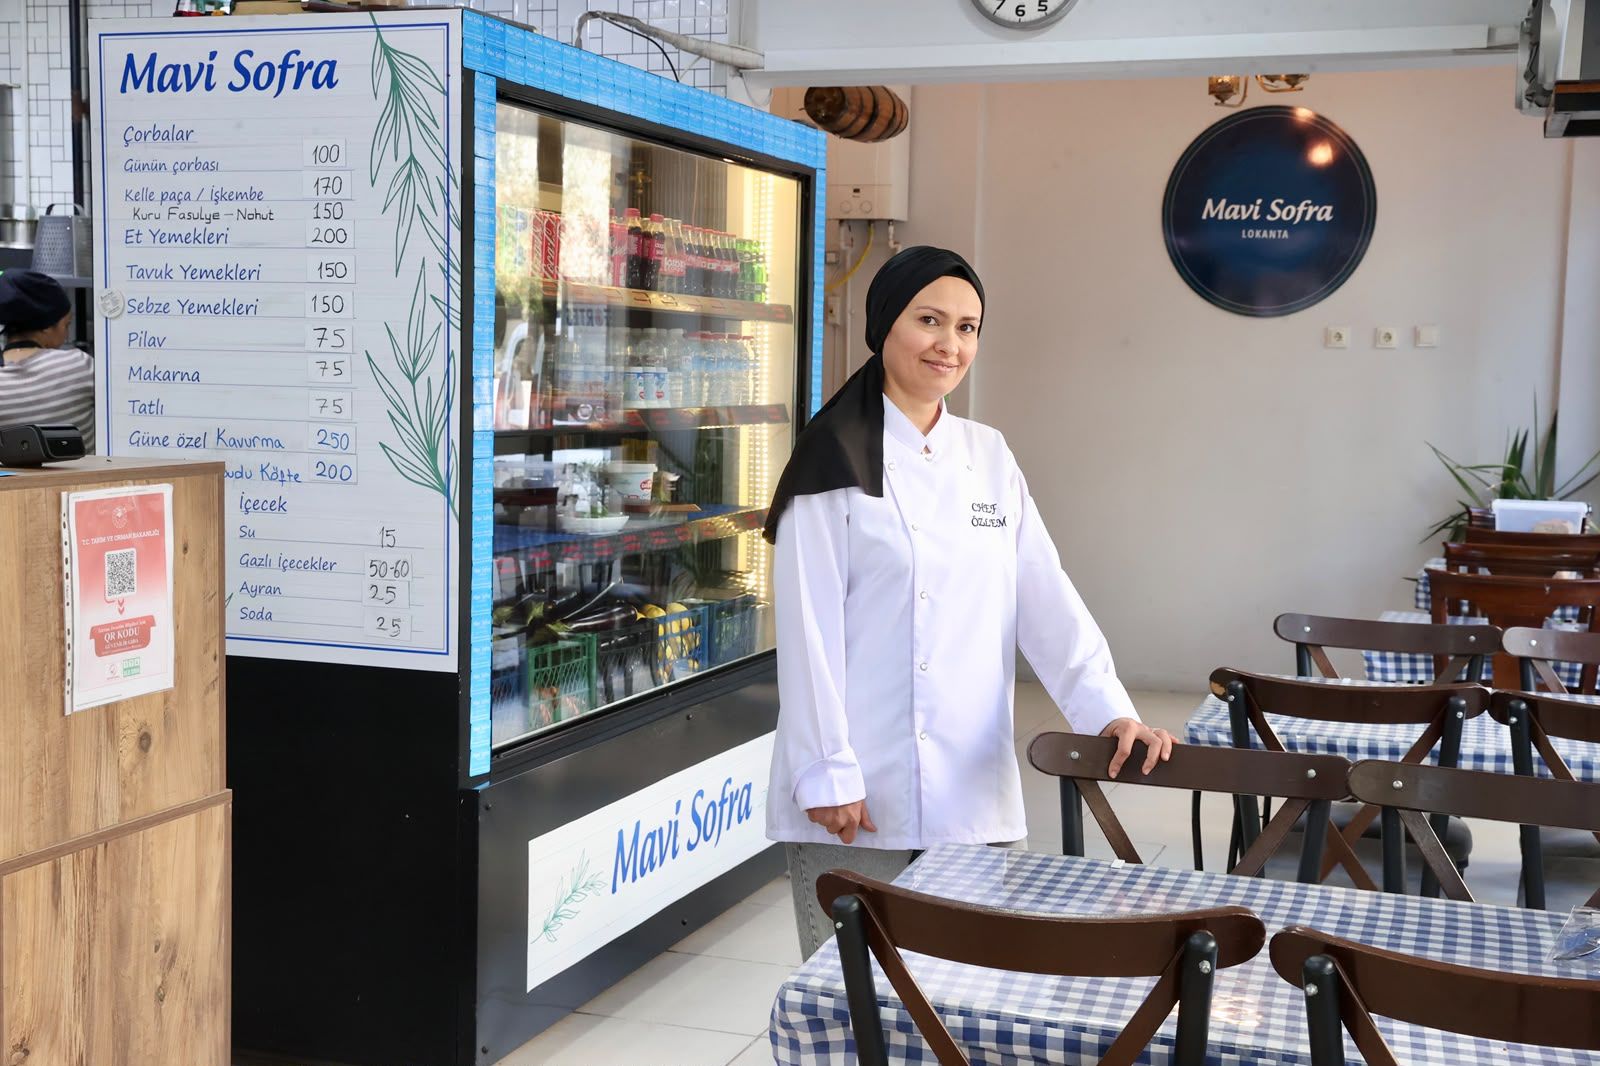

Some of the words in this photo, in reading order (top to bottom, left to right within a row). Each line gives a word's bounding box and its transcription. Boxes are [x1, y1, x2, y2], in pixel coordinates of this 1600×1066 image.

[1015, 5, 1025, 16] 6
[1038, 0, 1048, 11] 5
[120, 50, 218, 94] Mavi
[228, 49, 339, 98] Sofra
[124, 125, 194, 147] Çorbalar
[313, 144, 339, 164] 100
[124, 159, 167, 172] Günün
[173, 158, 219, 175] çorbası
[313, 176, 342, 195] 170
[125, 189, 156, 201] Kelle
[160, 192, 192, 205] paça
[211, 185, 263, 205] İşkembe
[133, 208, 161, 220] Kuru
[168, 207, 220, 224] Fasulye
[237, 208, 275, 221] Nohut
[313, 202, 343, 220] 150
[1201, 199, 1262, 220] Mavi
[1267, 199, 1333, 224] Sofra
[125, 229, 142, 245] Et
[149, 228, 229, 245] Yemekleri
[312, 228, 347, 244] 200
[1242, 229, 1288, 239] LOKANTA
[126, 264, 173, 280] Tavuk
[180, 264, 261, 282] Yemekleri
[318, 262, 347, 279] 150
[127, 299, 170, 314] Sebze
[178, 299, 258, 316] Yemekleri
[312, 295, 344, 313] 150
[129, 332, 166, 347] Pilav
[313, 328, 345, 348] 75
[128, 365, 200, 383] Makarna
[315, 361, 343, 377] 75
[129, 400, 163, 415] Tatlı
[316, 399, 342, 414] 75
[129, 430, 170, 446] Güne
[177, 432, 206, 449] özel
[216, 427, 285, 449] Kavurma
[317, 429, 350, 450] 250
[224, 464, 253, 479] udu
[316, 461, 352, 481] 200
[240, 492, 287, 514] İçecek
[240, 526, 255, 538] Su
[379, 527, 395, 548] 15
[240, 553, 272, 567] Gazlı
[370, 560, 409, 578] 50-60
[240, 582, 281, 597] Ayran
[370, 586, 396, 604] 25
[240, 608, 272, 621] Soda
[104, 632, 115, 642] QR
[118, 627, 139, 639] KODU
[376, 617, 400, 637] 25
[612, 800, 681, 895] Mavi
[687, 777, 752, 852] Sofra
